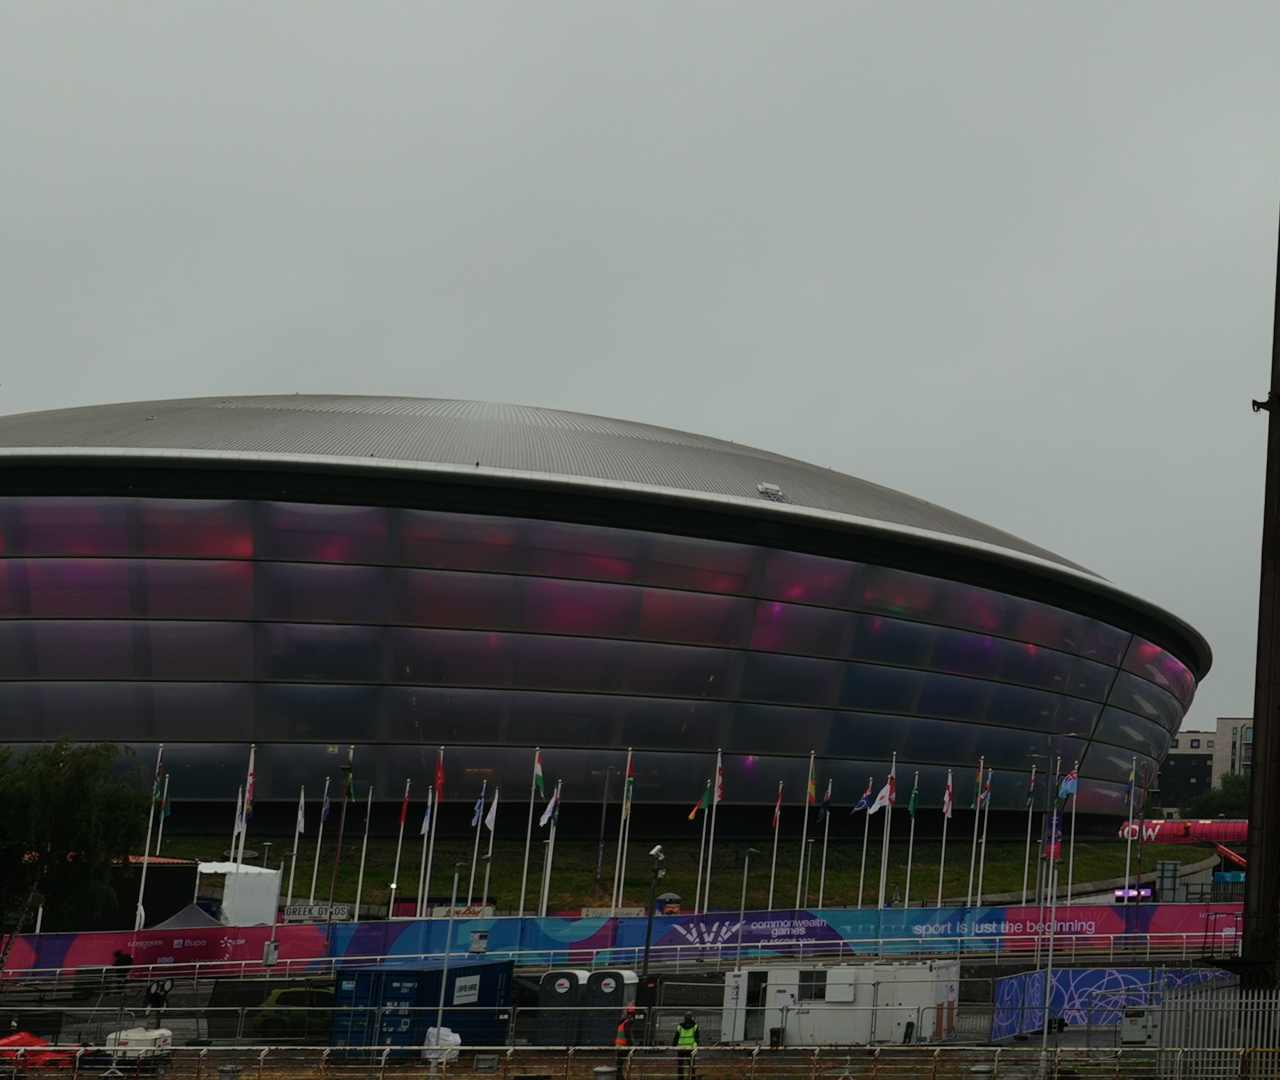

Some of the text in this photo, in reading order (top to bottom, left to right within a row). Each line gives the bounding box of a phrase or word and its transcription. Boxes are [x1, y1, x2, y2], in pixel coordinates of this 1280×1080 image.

[286, 906, 313, 916] GREEK
[751, 918, 827, 930] commonwealth
[913, 919, 1095, 937] sport is just the beginning
[771, 926, 806, 938] games
[184, 939, 207, 949] Bupa
